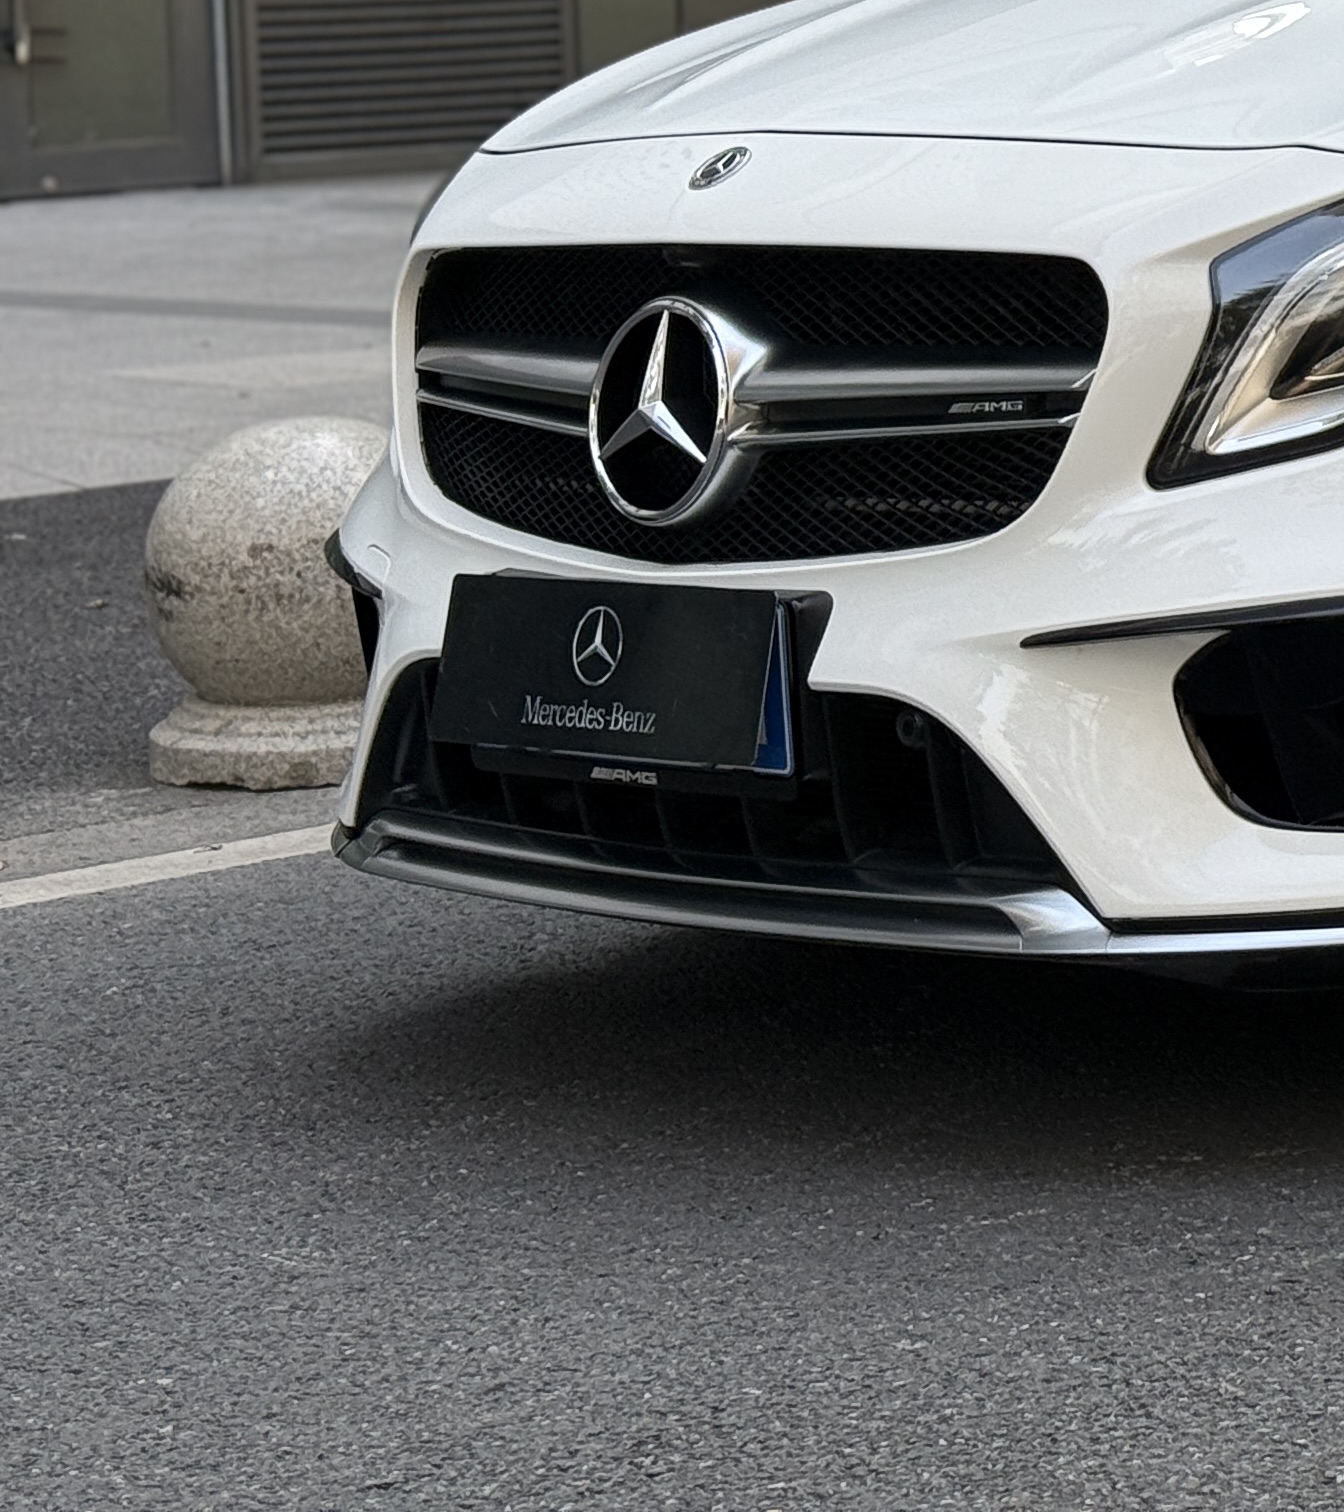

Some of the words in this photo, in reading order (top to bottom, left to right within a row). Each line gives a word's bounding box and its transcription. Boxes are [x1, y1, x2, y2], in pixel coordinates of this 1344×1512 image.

[971, 400, 1024, 413] AMG
[520, 694, 657, 734] Mercedes-Benz
[609, 768, 658, 785] AMG
